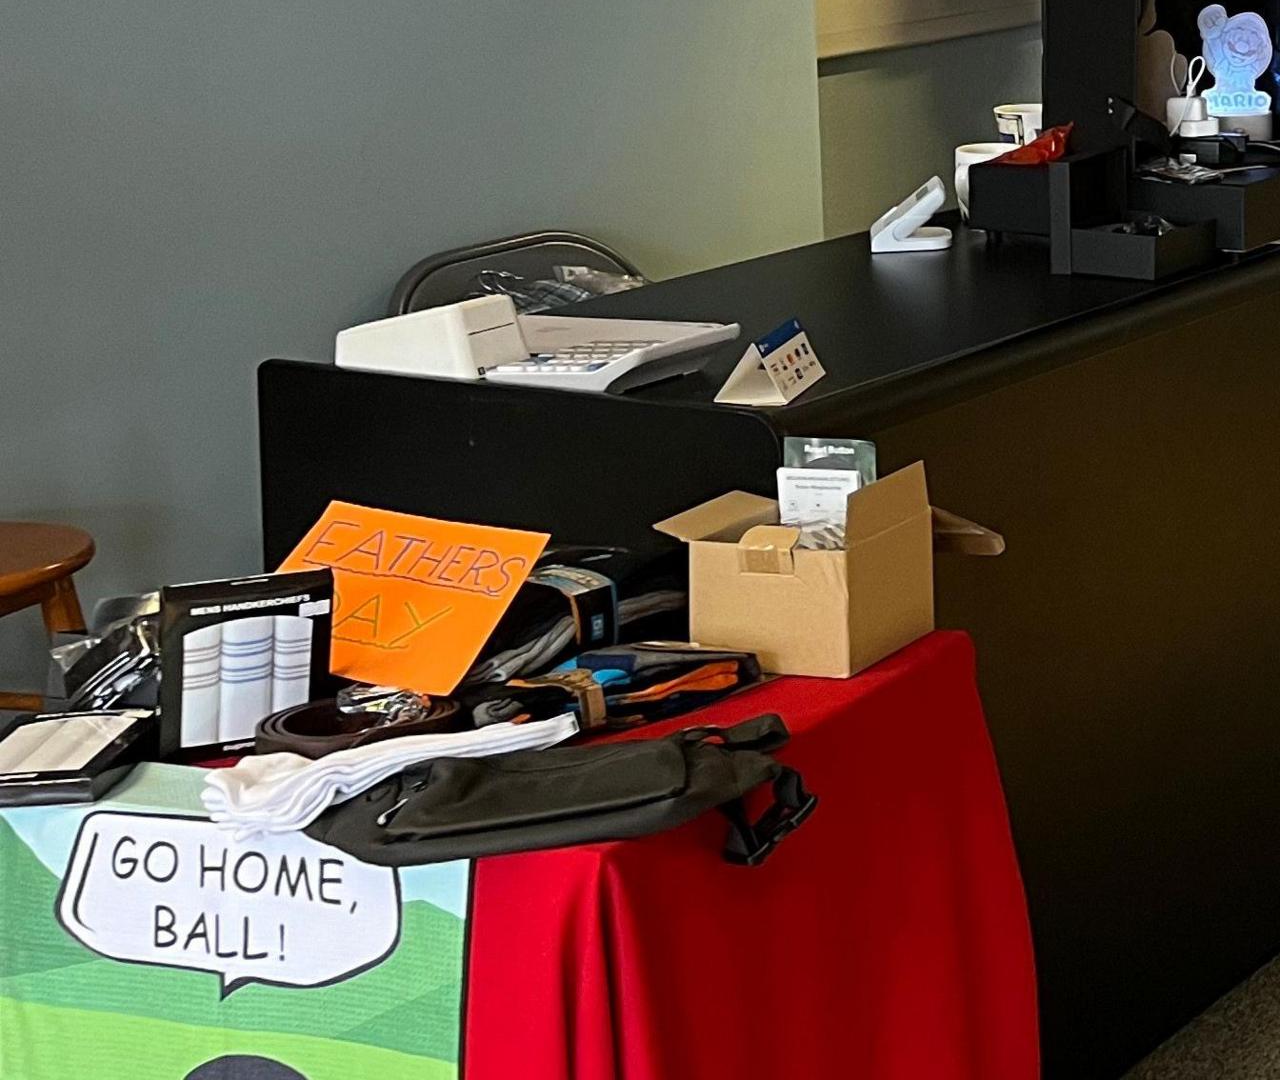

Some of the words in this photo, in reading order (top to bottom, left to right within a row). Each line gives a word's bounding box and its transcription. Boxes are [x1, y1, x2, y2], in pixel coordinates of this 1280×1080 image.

[305, 520, 527, 595] FATHERS
[112, 835, 178, 884] GO
[200, 844, 358, 914] HOME,
[154, 905, 287, 961] BALL!
